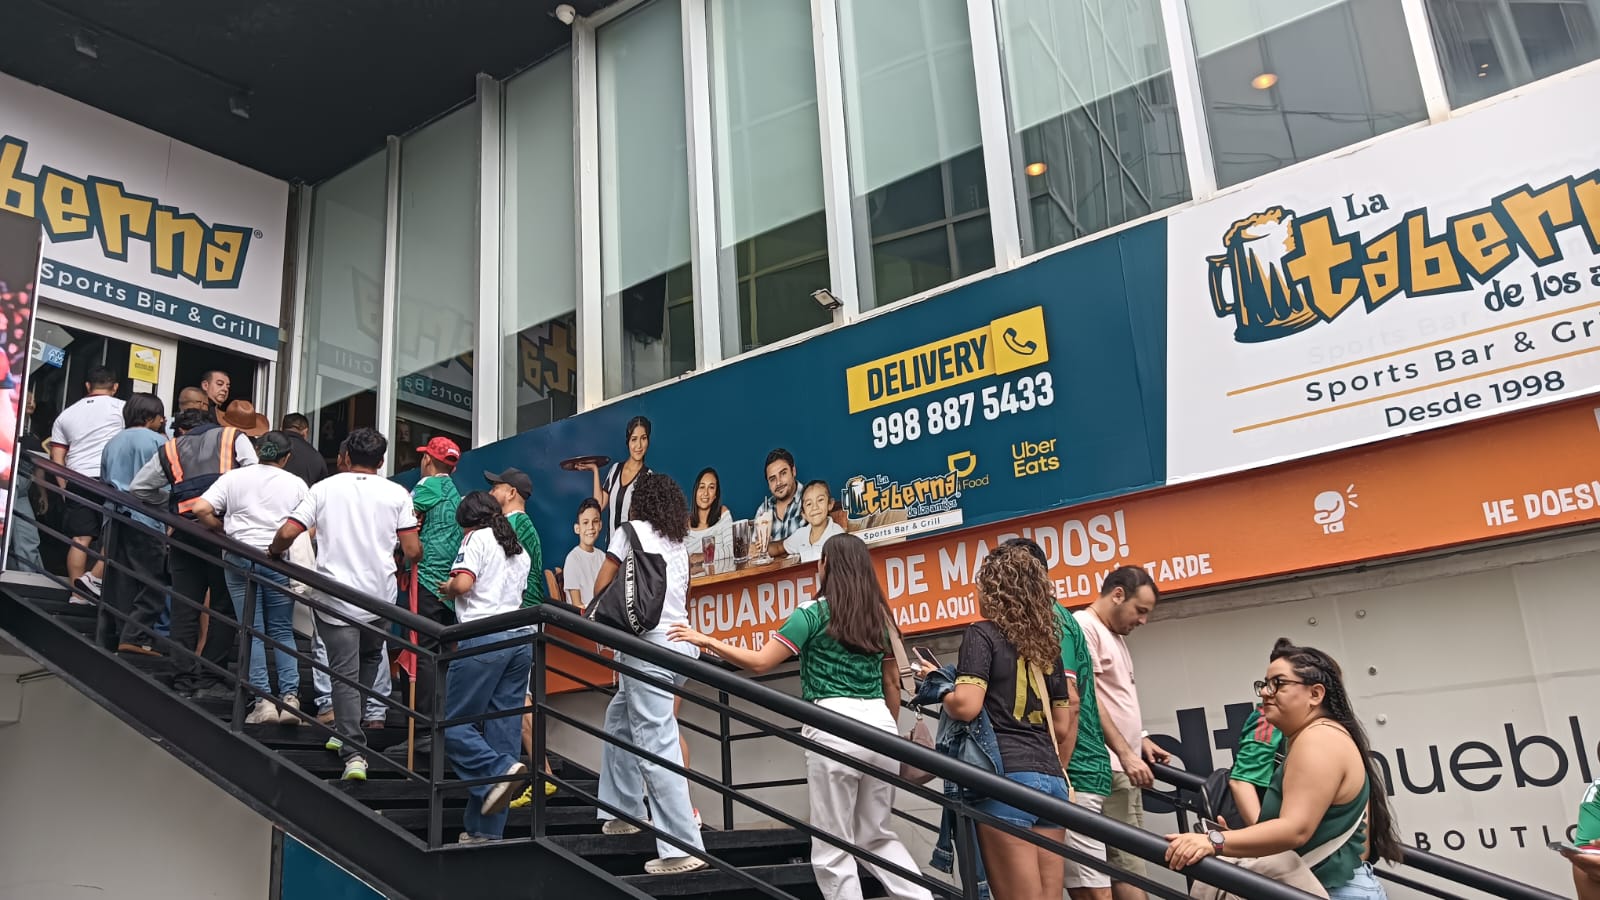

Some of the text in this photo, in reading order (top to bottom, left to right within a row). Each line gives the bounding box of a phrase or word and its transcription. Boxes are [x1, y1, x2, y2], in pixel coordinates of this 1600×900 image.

[1341, 190, 1389, 222] La
[40, 264, 261, 341] Sports Bar & Grill
[1484, 279, 1525, 312] de
[1530, 271, 1581, 302] los
[867, 334, 988, 401] DELIVERY
[1306, 318, 1600, 402] Sports Bar & Gr
[872, 371, 1055, 448] 998 887 5433
[1384, 370, 1566, 428] Desde 1998
[1012, 438, 1057, 460] Uber
[1014, 454, 1060, 478] Eats
[862, 469, 958, 515] taberna
[963, 474, 989, 489] Food
[864, 529, 892, 541] Sports
[894, 524, 909, 533] Bar
[920, 517, 940, 528] Grill
[1482, 499, 1518, 527] HE
[886, 553, 929, 600] DE
[935, 592, 975, 619] AQUÍ
[1143, 553, 1213, 583] TARDE
